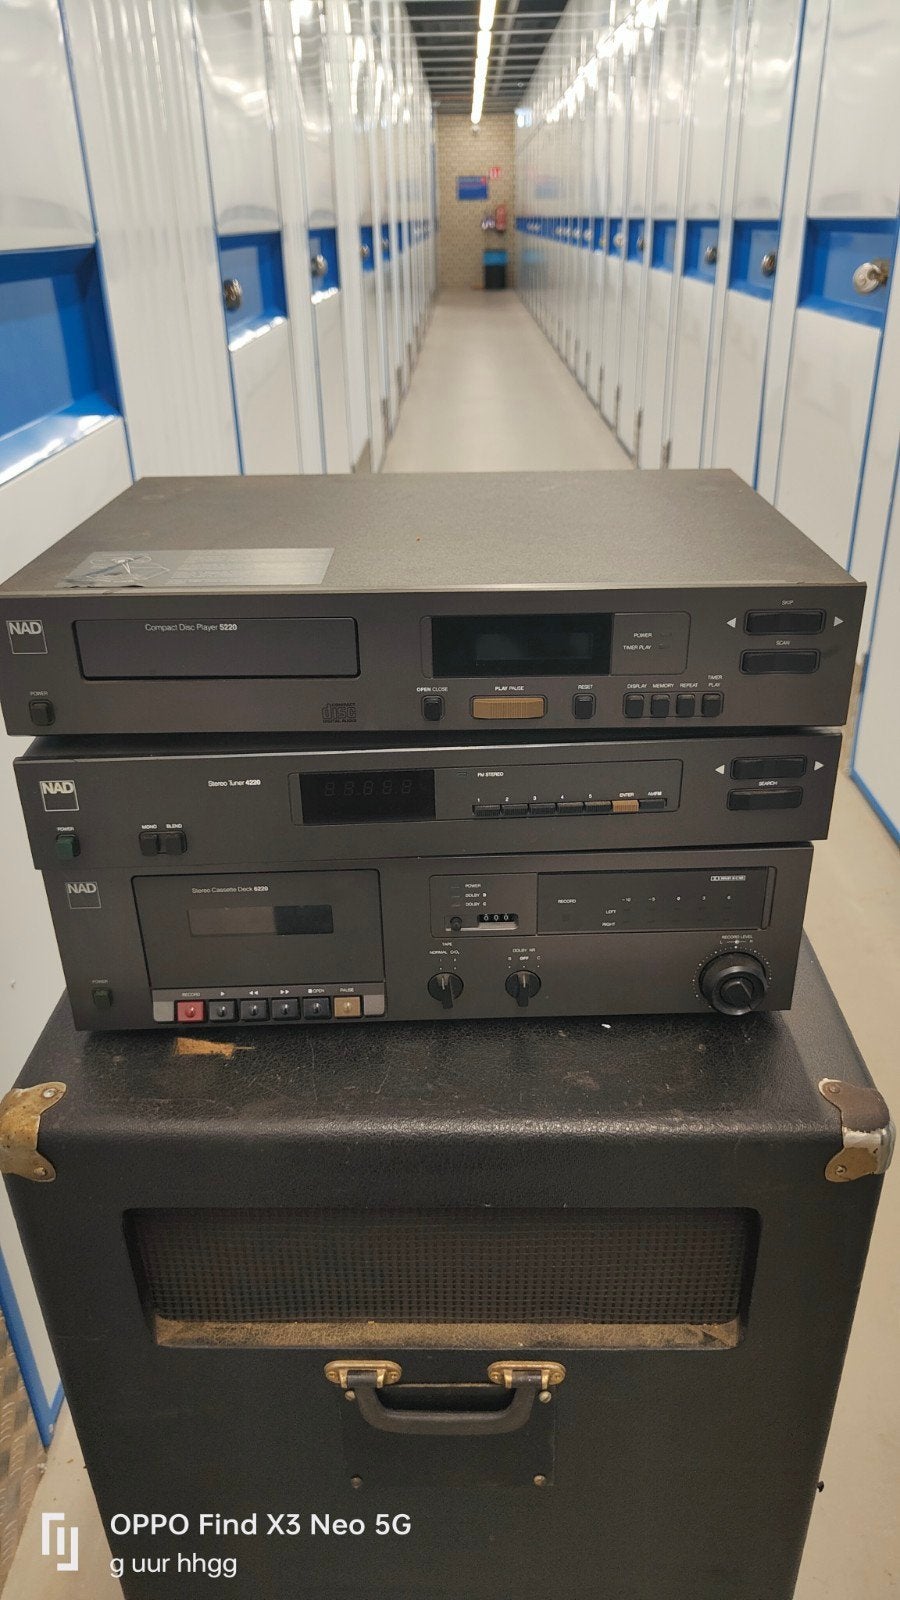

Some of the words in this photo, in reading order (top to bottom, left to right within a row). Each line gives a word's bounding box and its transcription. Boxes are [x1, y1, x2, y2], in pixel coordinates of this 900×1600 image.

[8, 621, 42, 635] NAD
[145, 624, 178, 632] Compact
[179, 623, 195, 631] Disc
[196, 623, 218, 632] Player
[219, 623, 238, 631] 5220
[42, 782, 74, 794] NAD
[67, 883, 98, 895] NAD
